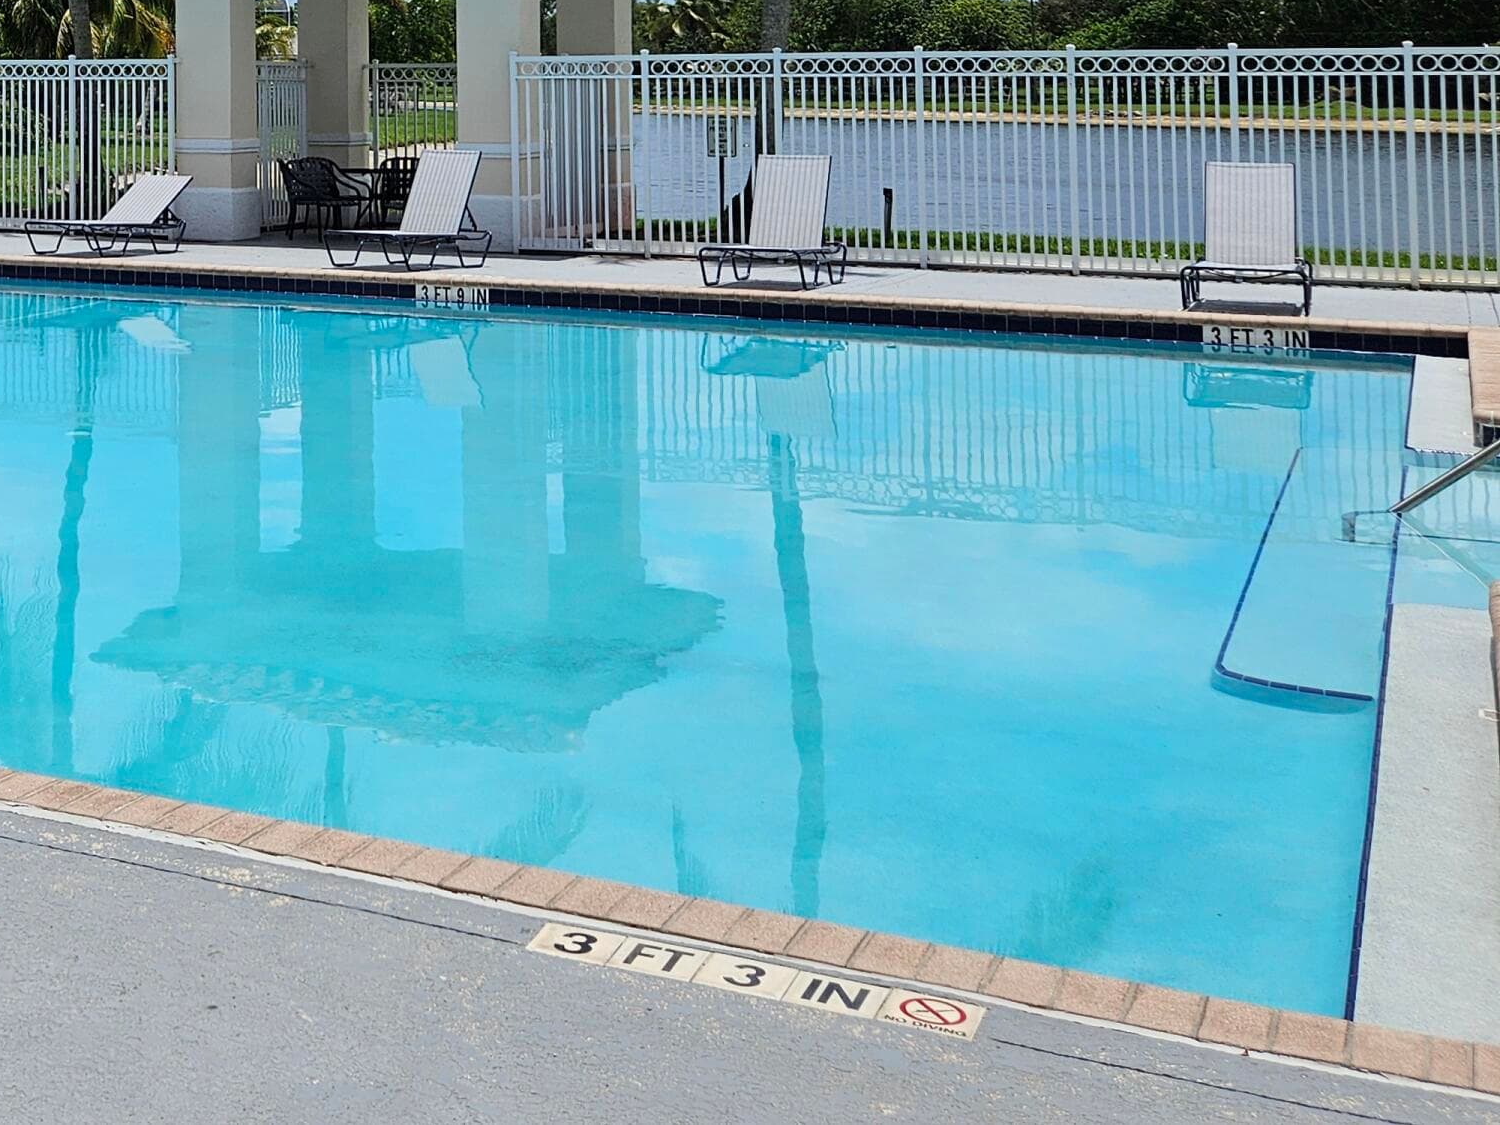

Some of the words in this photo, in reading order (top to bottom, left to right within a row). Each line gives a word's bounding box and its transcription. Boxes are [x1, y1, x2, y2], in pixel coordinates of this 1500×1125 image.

[421, 285, 429, 300] 3
[434, 286, 451, 302] FT
[457, 287, 465, 303] 9
[472, 288, 487, 305] IN
[1211, 326, 1221, 345] 3
[1230, 328, 1254, 346] FT
[1263, 329, 1274, 347] 3
[1285, 330, 1307, 348] IN
[553, 932, 598, 954] 3
[623, 943, 695, 972] FT
[722, 964, 766, 987] 3
[801, 978, 870, 1011] IN
[884, 1014, 907, 1024] NO
[912, 1020, 967, 1037] DIVING
